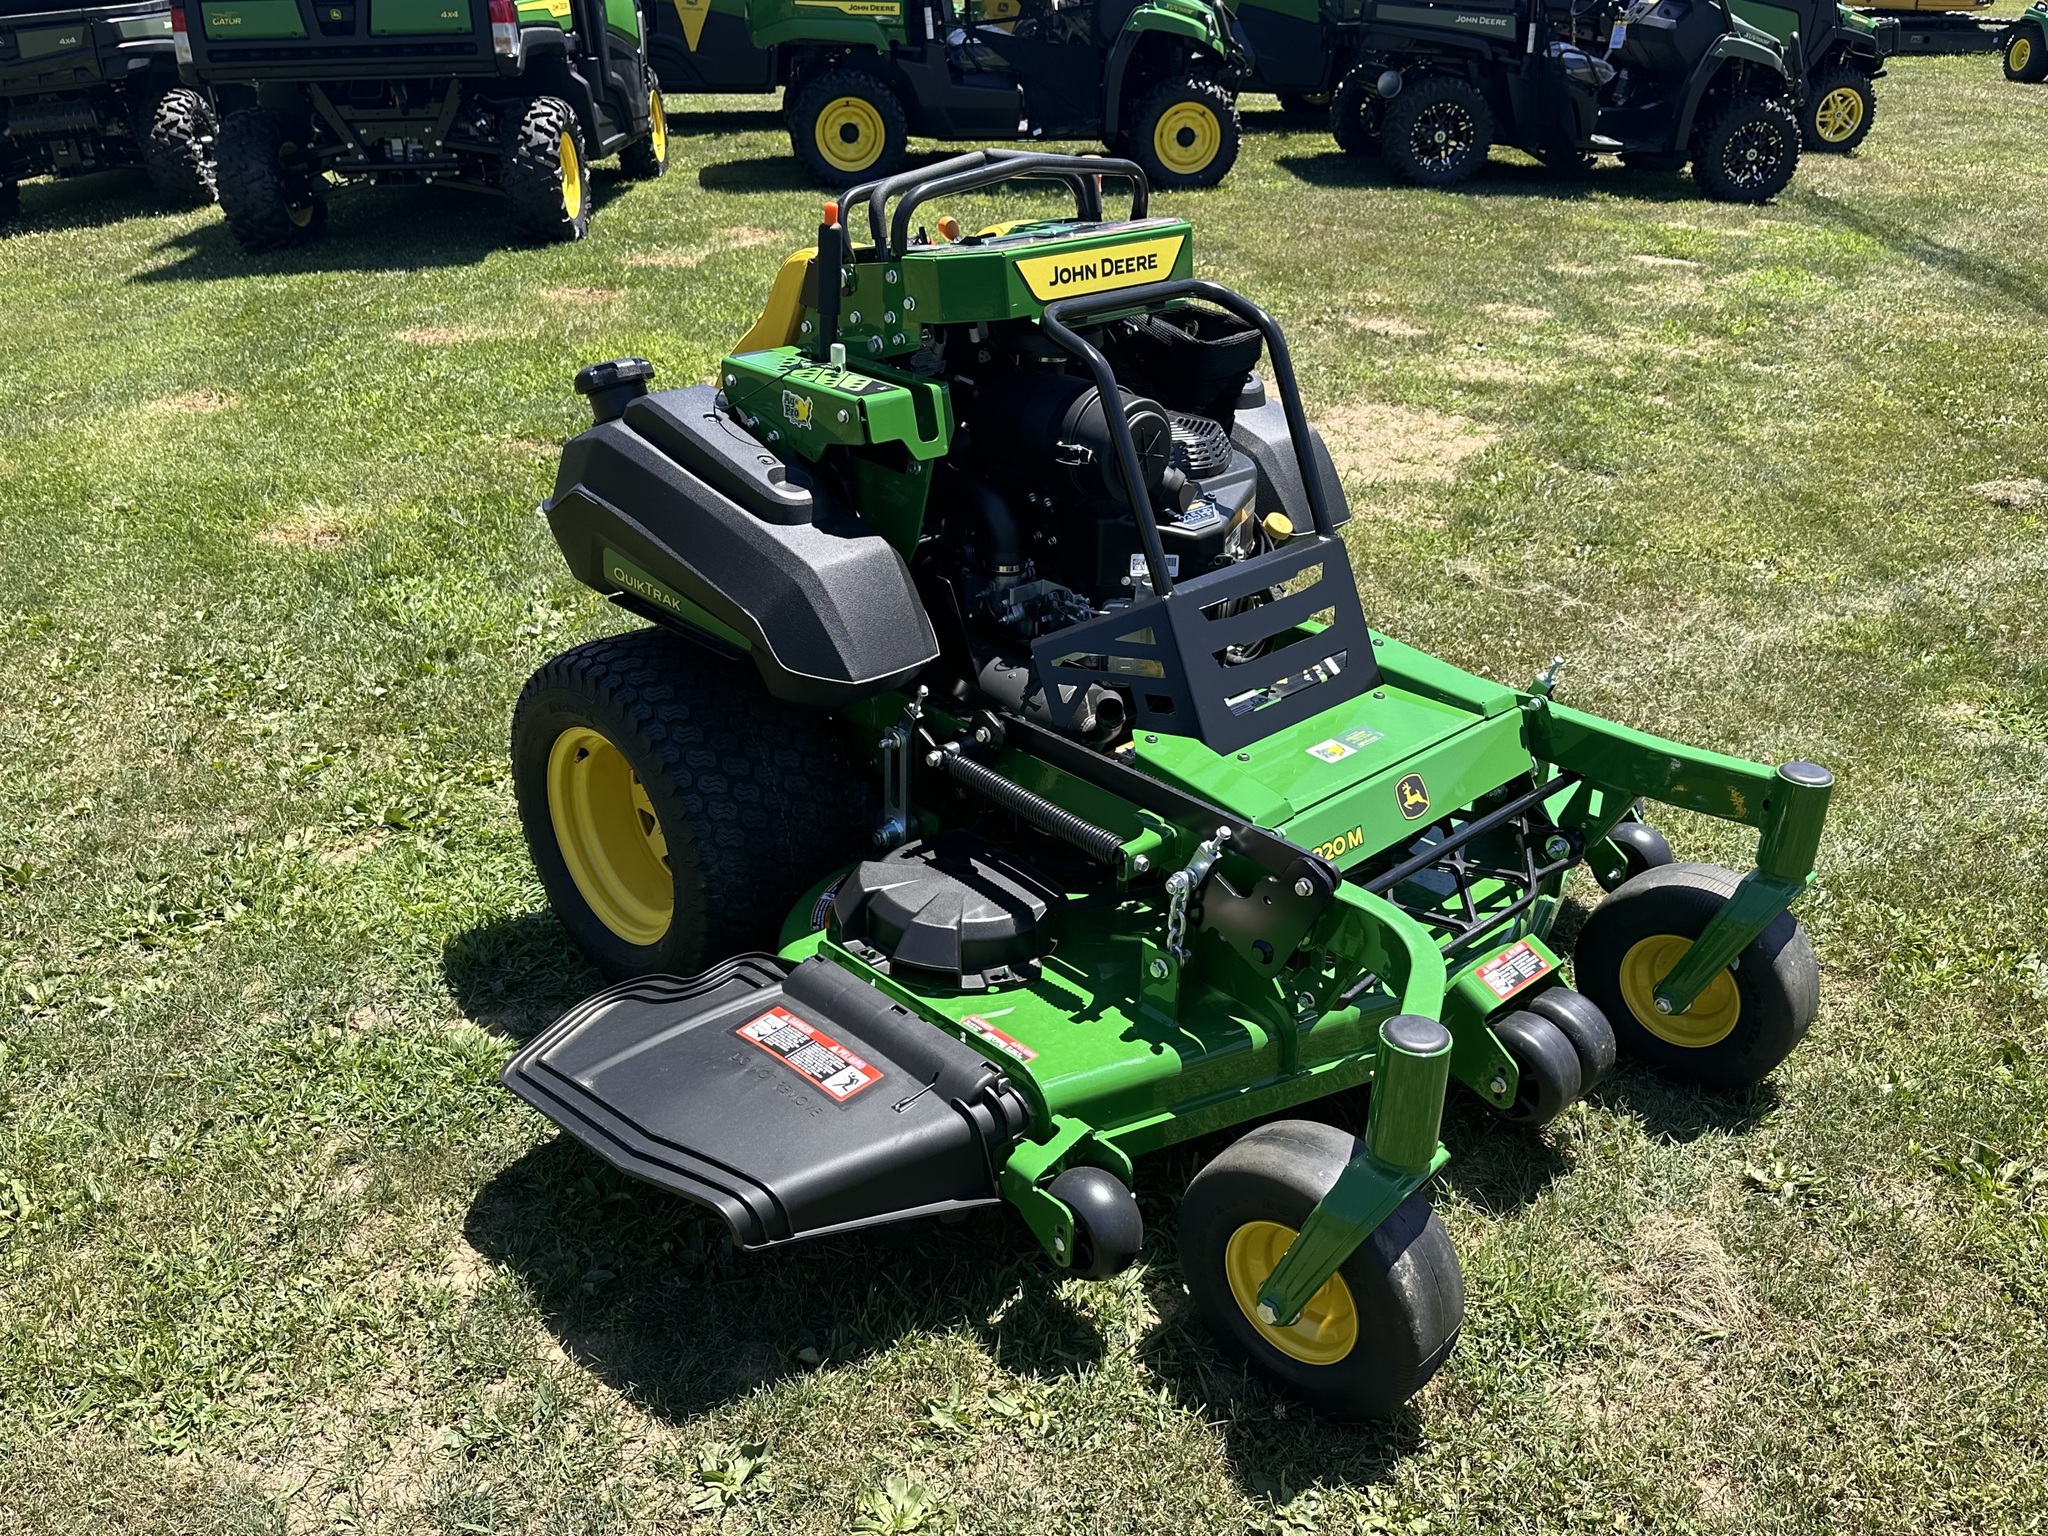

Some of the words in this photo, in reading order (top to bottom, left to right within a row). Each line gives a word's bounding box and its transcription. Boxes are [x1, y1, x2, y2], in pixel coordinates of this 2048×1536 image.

[848, 3, 869, 12] JOHN
[870, 4, 896, 12] DEERE
[211, 17, 242, 26] GATOR
[1455, 14, 1478, 24] JOHN
[1479, 16, 1508, 26] DEERE
[1049, 263, 1097, 287] JOHN
[1101, 253, 1158, 277] DEERE
[613, 567, 681, 611] QUIKTRAK
[837, 1047, 867, 1070] PELIGRO
[729, 1051, 751, 1066] DO
[749, 1064, 777, 1081] NOT
[776, 1080, 824, 1117] REMOVE
